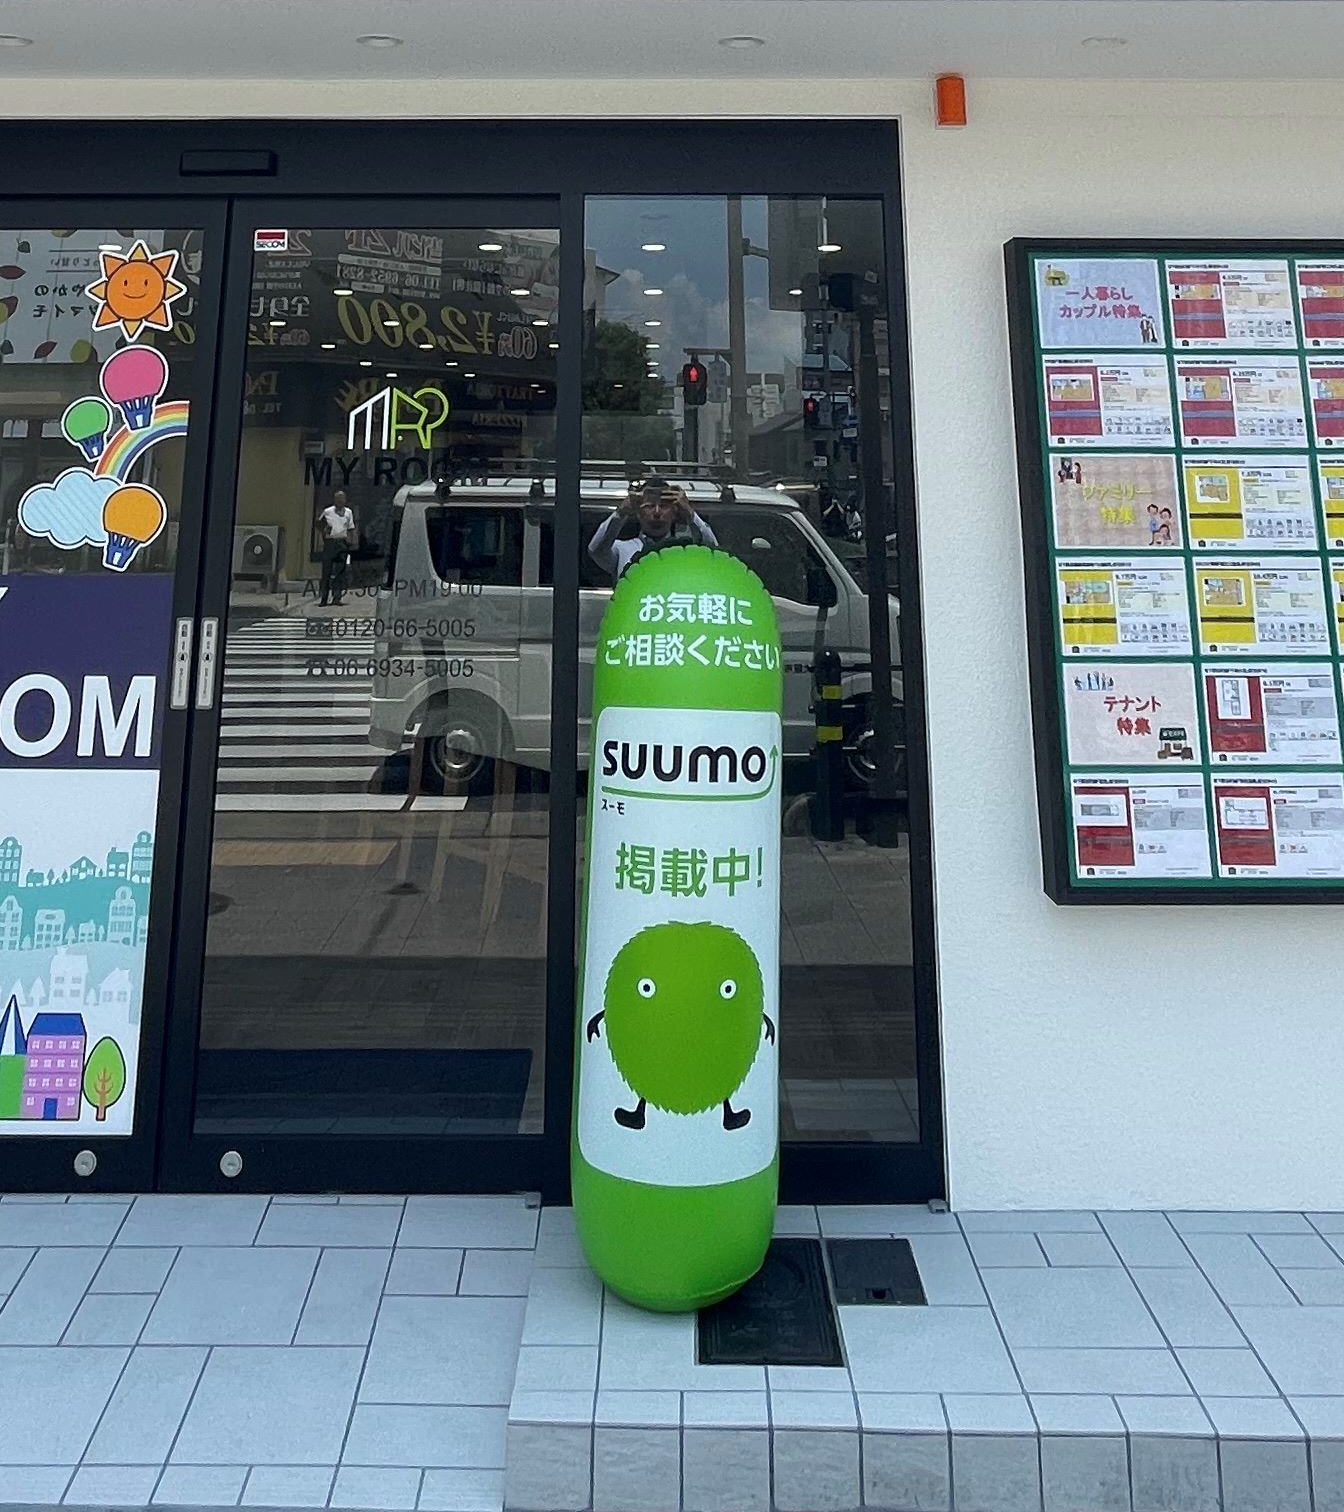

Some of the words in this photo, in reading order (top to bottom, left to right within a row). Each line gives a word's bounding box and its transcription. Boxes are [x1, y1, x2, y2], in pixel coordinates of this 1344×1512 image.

[256, 240, 286, 249] SECOM
[1065, 285, 1133, 302] 一人暮らし
[1059, 303, 1143, 320] カップル特集
[304, 457, 359, 486] MY
[639, 592, 753, 625] お気軽に
[335, 618, 476, 638] 0120-66-5005
[605, 633, 780, 670] ご相談ください
[1103, 694, 1162, 713] テナント
[1116, 716, 1152, 736] 特集
[601, 798, 626, 816] スーモ
